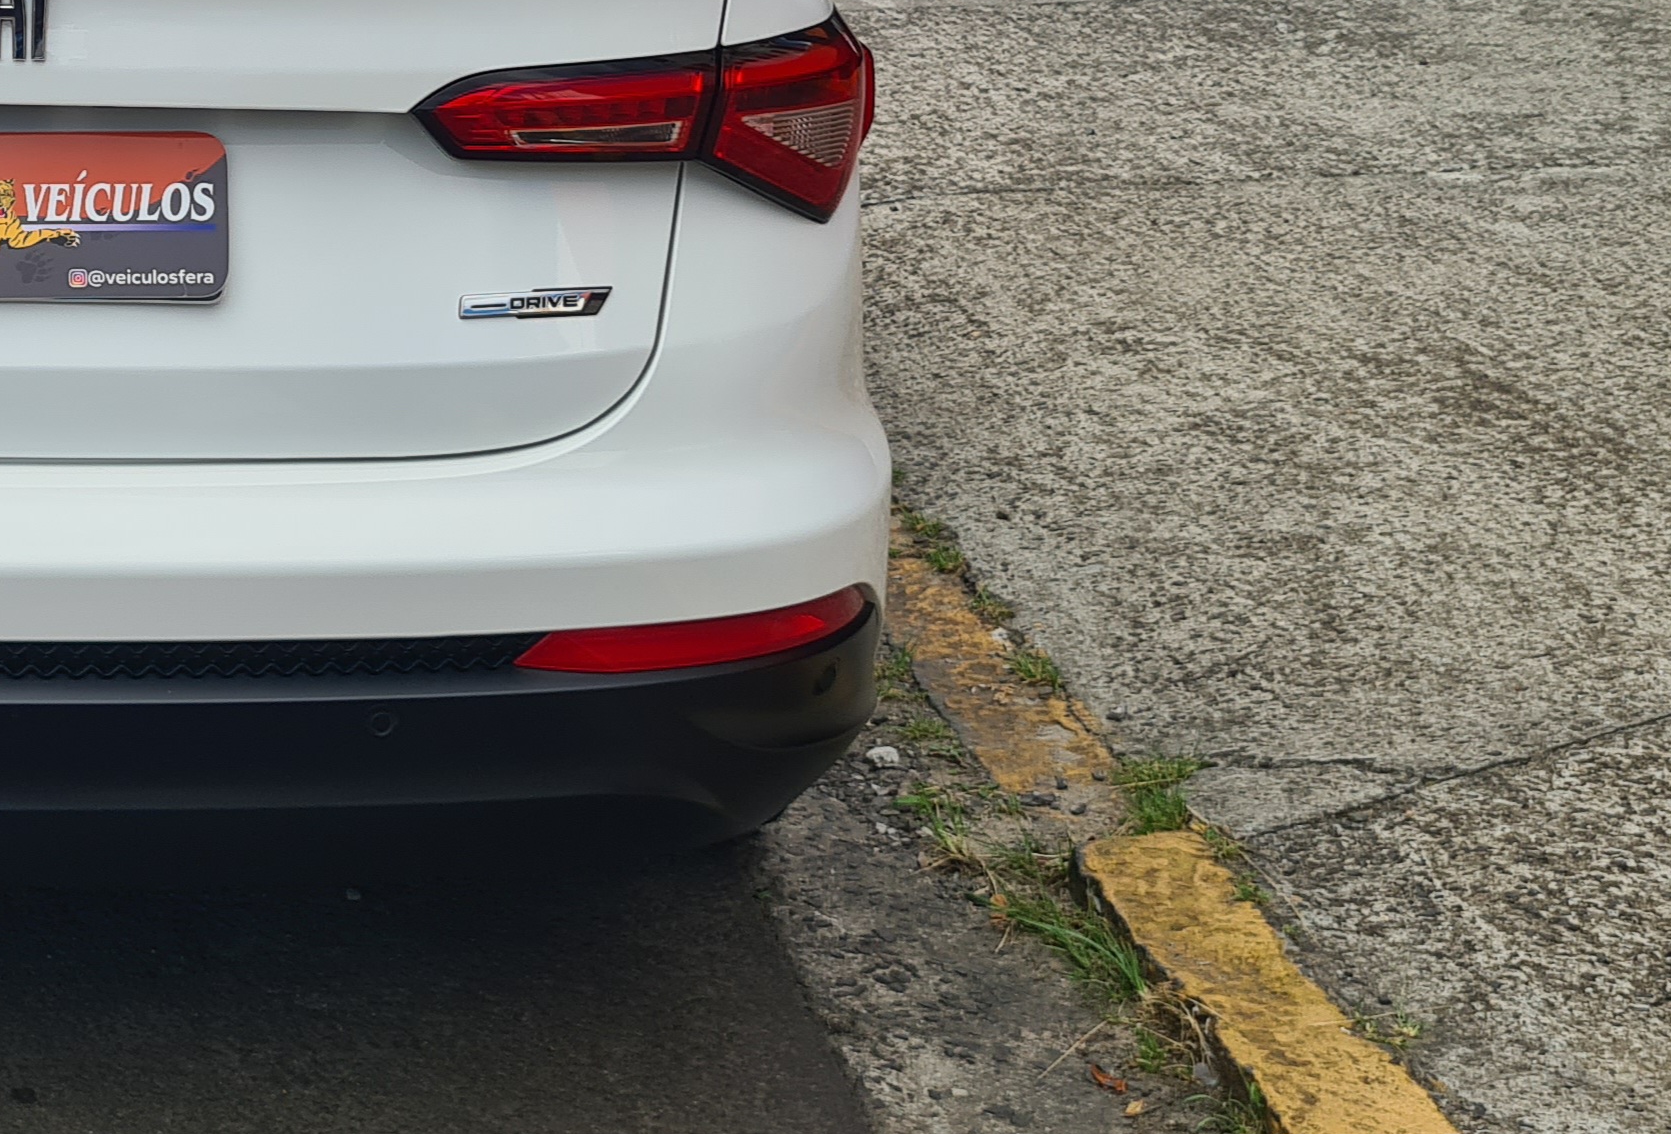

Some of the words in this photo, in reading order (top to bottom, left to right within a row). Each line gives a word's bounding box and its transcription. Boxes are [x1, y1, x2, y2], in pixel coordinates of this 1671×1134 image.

[22, 170, 216, 224] VEÍCULOS
[88, 268, 215, 287] @veiculosfera
[510, 295, 578, 309] DRIVE
